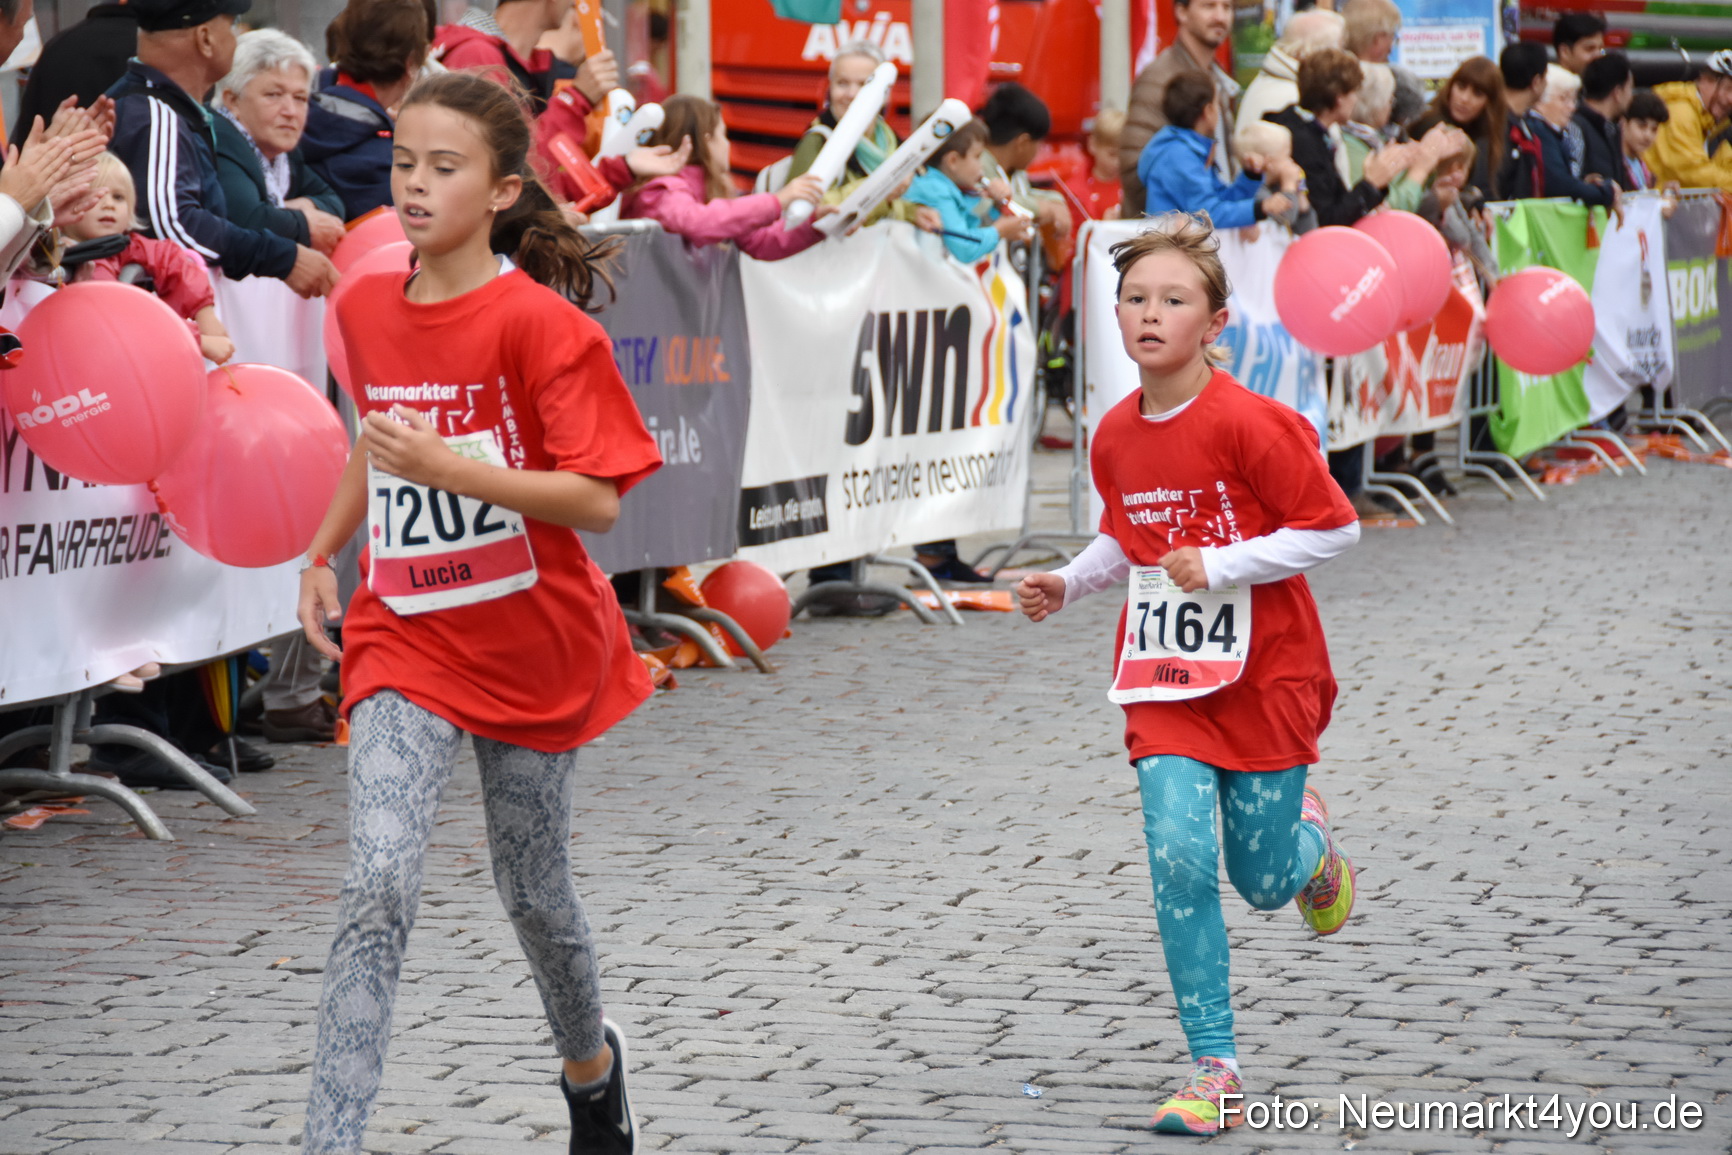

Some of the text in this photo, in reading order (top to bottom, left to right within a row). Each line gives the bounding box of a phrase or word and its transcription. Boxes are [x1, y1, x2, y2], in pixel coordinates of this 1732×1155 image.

[844, 304, 971, 446] swn
[61, 401, 111, 428] energie
[14, 512, 171, 577] FAHRFREUDE.
[408, 560, 473, 589] Lucia
[1137, 601, 1237, 653] 7164
